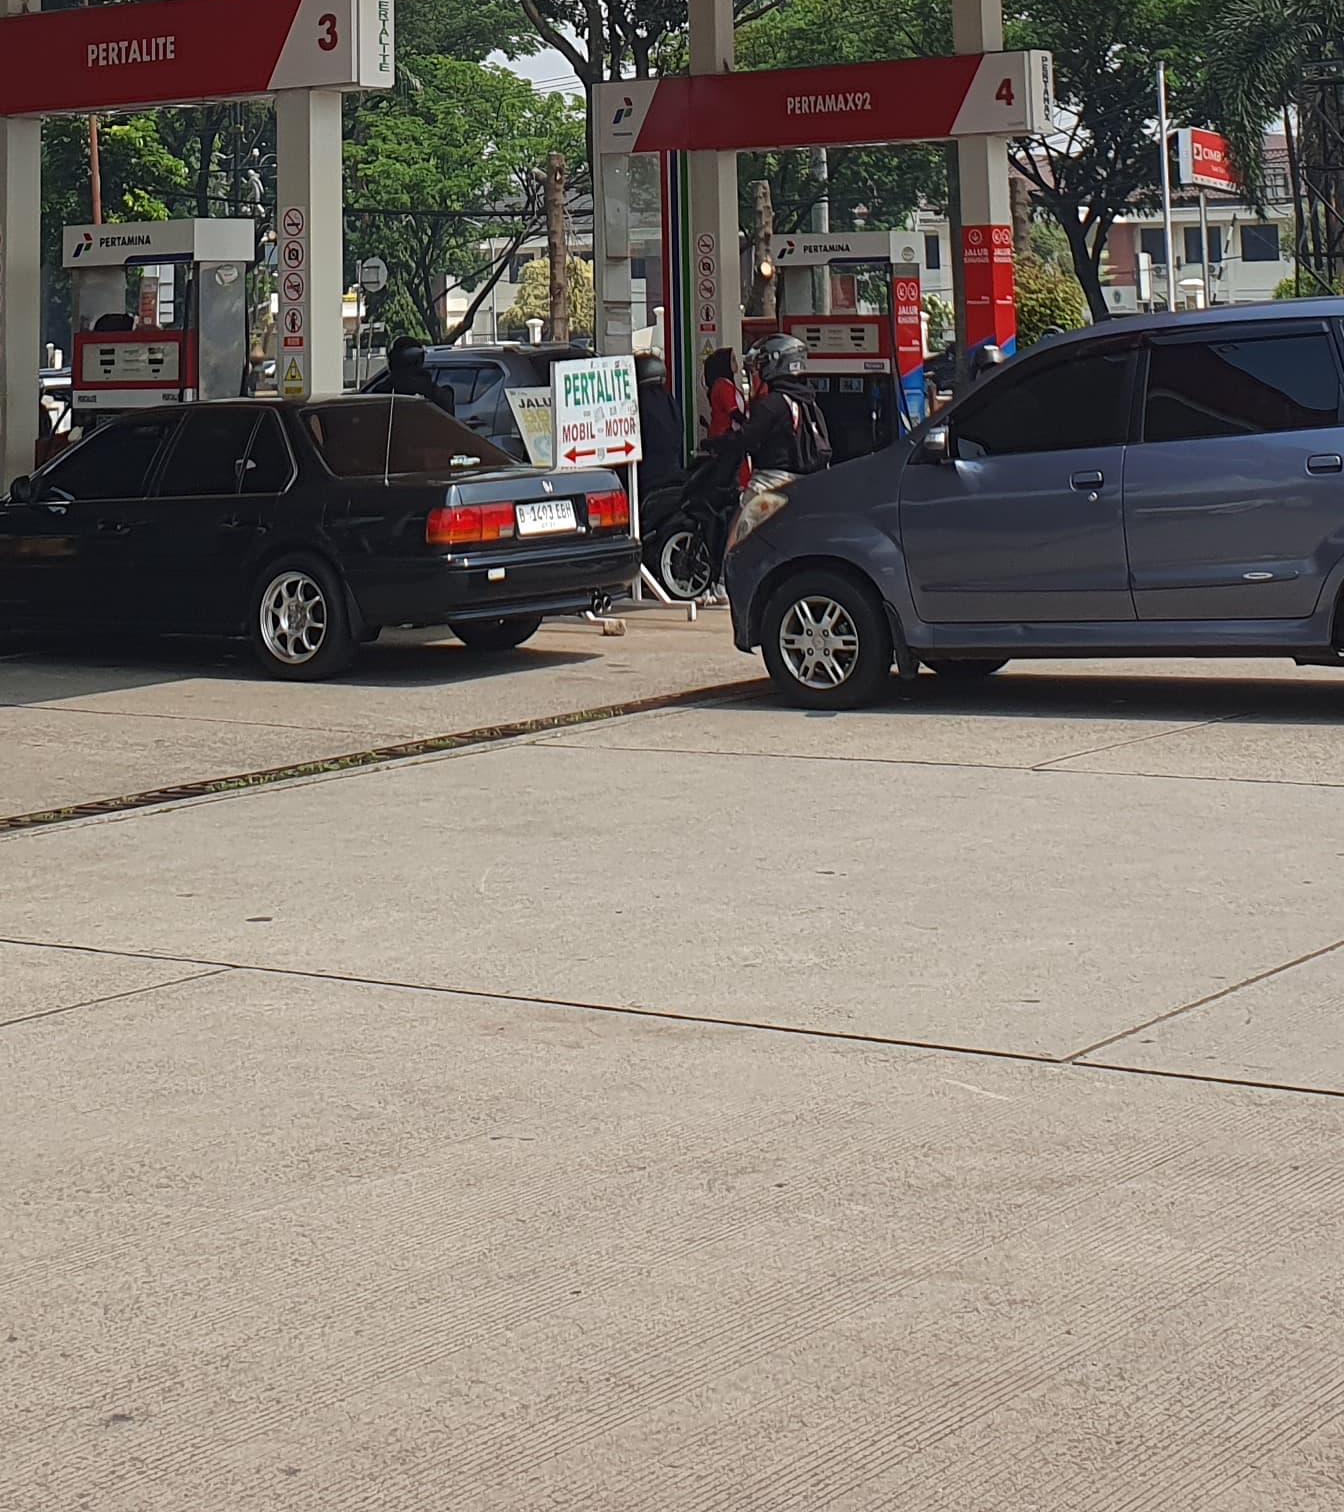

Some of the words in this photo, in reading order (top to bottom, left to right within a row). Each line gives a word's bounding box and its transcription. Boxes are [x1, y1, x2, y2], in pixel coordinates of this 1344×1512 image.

[318, 13, 338, 51] 3
[87, 36, 175, 67] PERTALITE
[787, 92, 871, 115] PERTAMAX92
[996, 78, 1014, 106] 4
[99, 235, 151, 248] PERTAMINA
[803, 244, 850, 255] PERTAMINA
[564, 368, 631, 407] PERTALITE
[519, 397, 552, 409] JALU
[562, 421, 596, 444] MOBIL
[605, 417, 636, 438] MOTOR
[518, 507, 526, 523] B
